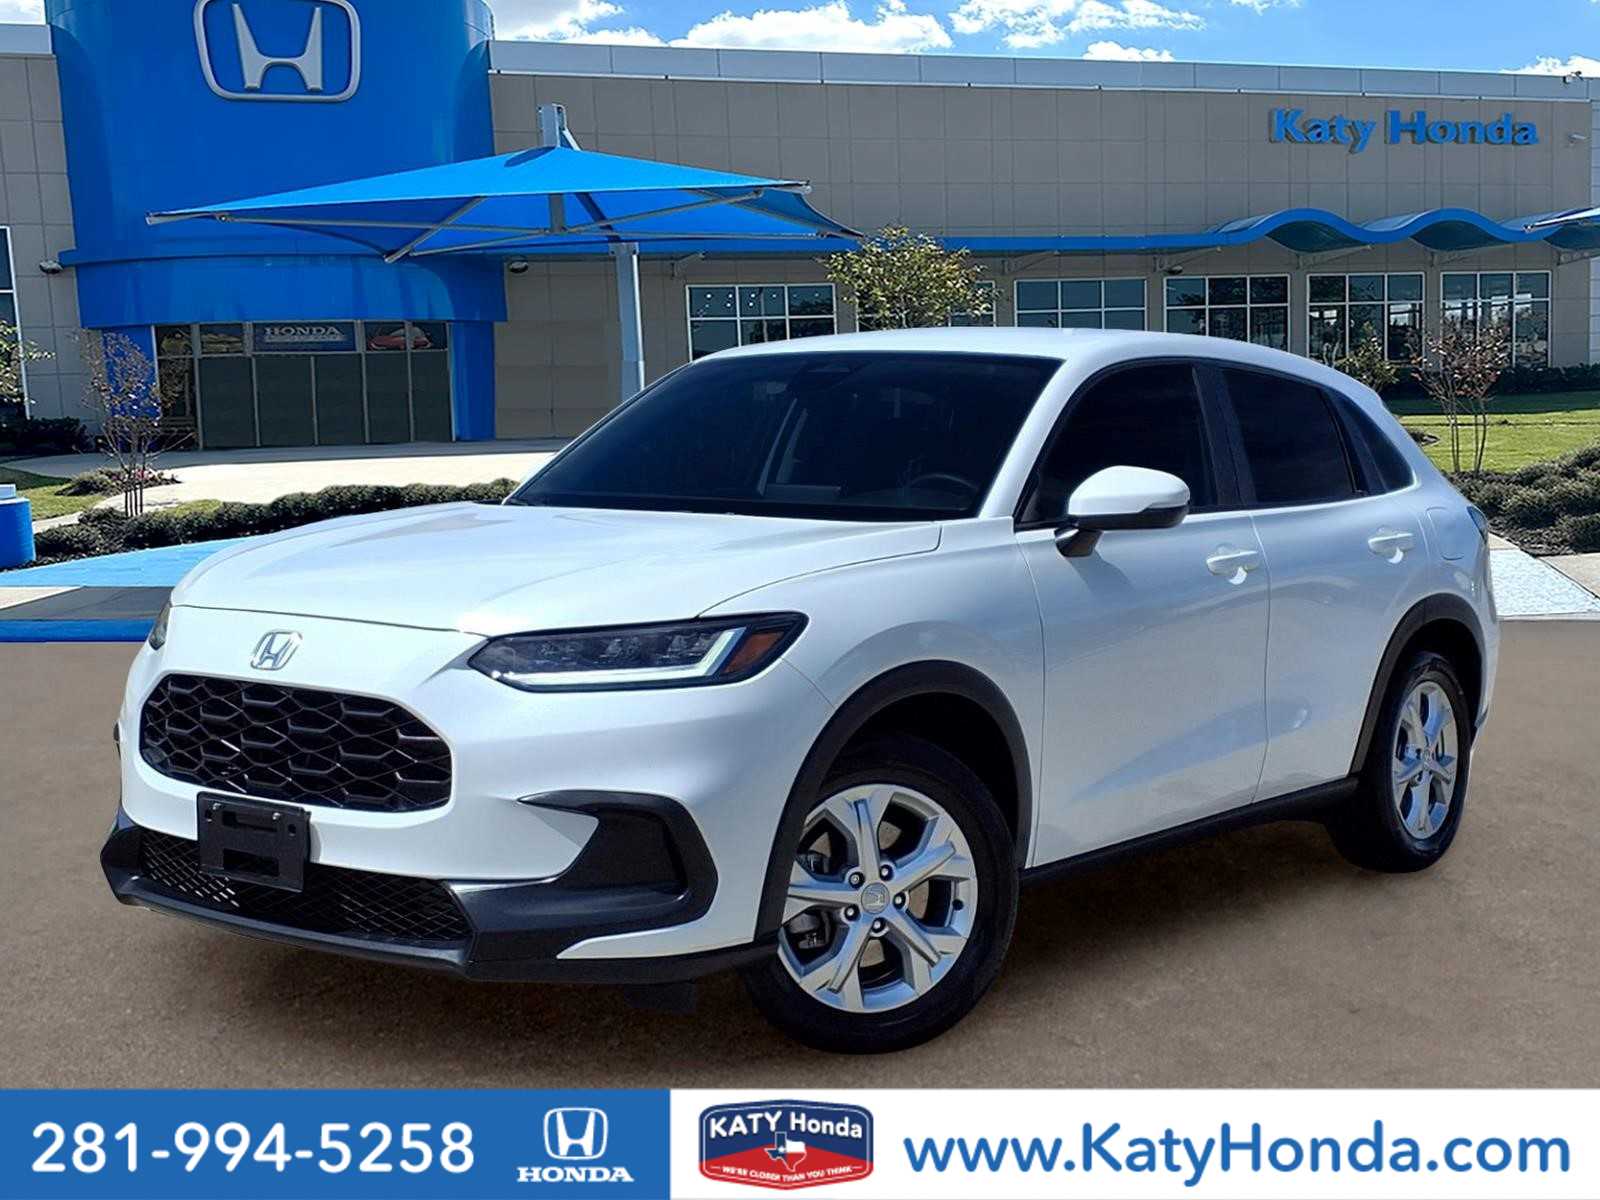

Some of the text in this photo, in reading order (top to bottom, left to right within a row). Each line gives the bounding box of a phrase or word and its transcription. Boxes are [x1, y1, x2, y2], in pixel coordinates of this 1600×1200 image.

[1269, 107, 1539, 154] Katy Honda
[264, 326, 344, 336] HONDA
